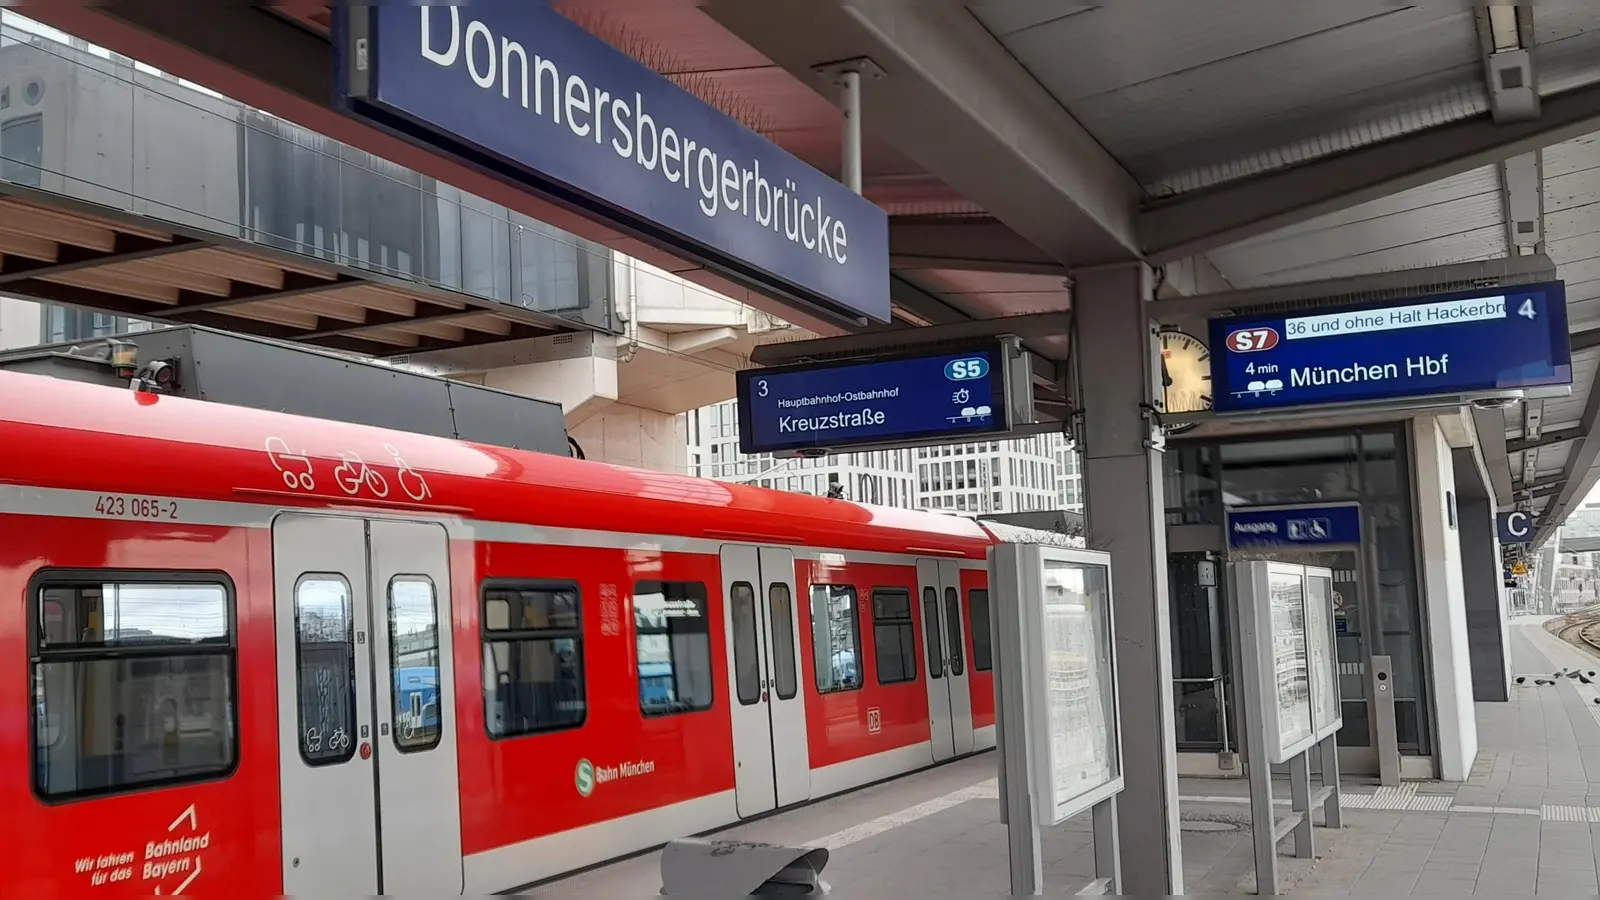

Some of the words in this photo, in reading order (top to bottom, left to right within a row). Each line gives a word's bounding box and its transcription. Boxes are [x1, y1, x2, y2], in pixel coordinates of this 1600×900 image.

[421, 6, 848, 265] Donnersbergerbrücke
[1516, 298, 1538, 321] 4
[1287, 321, 1307, 336] 36
[1311, 318, 1340, 333] und
[1345, 314, 1385, 330] ohne
[1389, 310, 1422, 326] Halt
[1235, 330, 1269, 351] S7
[952, 360, 981, 379] S5
[1245, 362, 1256, 375] 4
[1257, 362, 1279, 374] min
[1290, 359, 1398, 388] München
[1406, 353, 1450, 377] Hbf
[757, 380, 769, 397] 3
[777, 386, 899, 409] Hauptbahnhof-Ostbahnhof
[778, 407, 886, 433] Kreuzstraße
[95, 496, 125, 516] 423
[131, 498, 178, 519] 065-2
[1507, 512, 1528, 536] C
[869, 711, 879, 730] DB
[578, 761, 593, 794] S
[619, 758, 655, 778] München
[145, 831, 211, 860] Bahnland
[75, 858, 93, 873] Wir
[96, 851, 135, 869] fahren
[142, 857, 190, 880] Bayern
[91, 871, 107, 886] für
[109, 866, 132, 883] das
